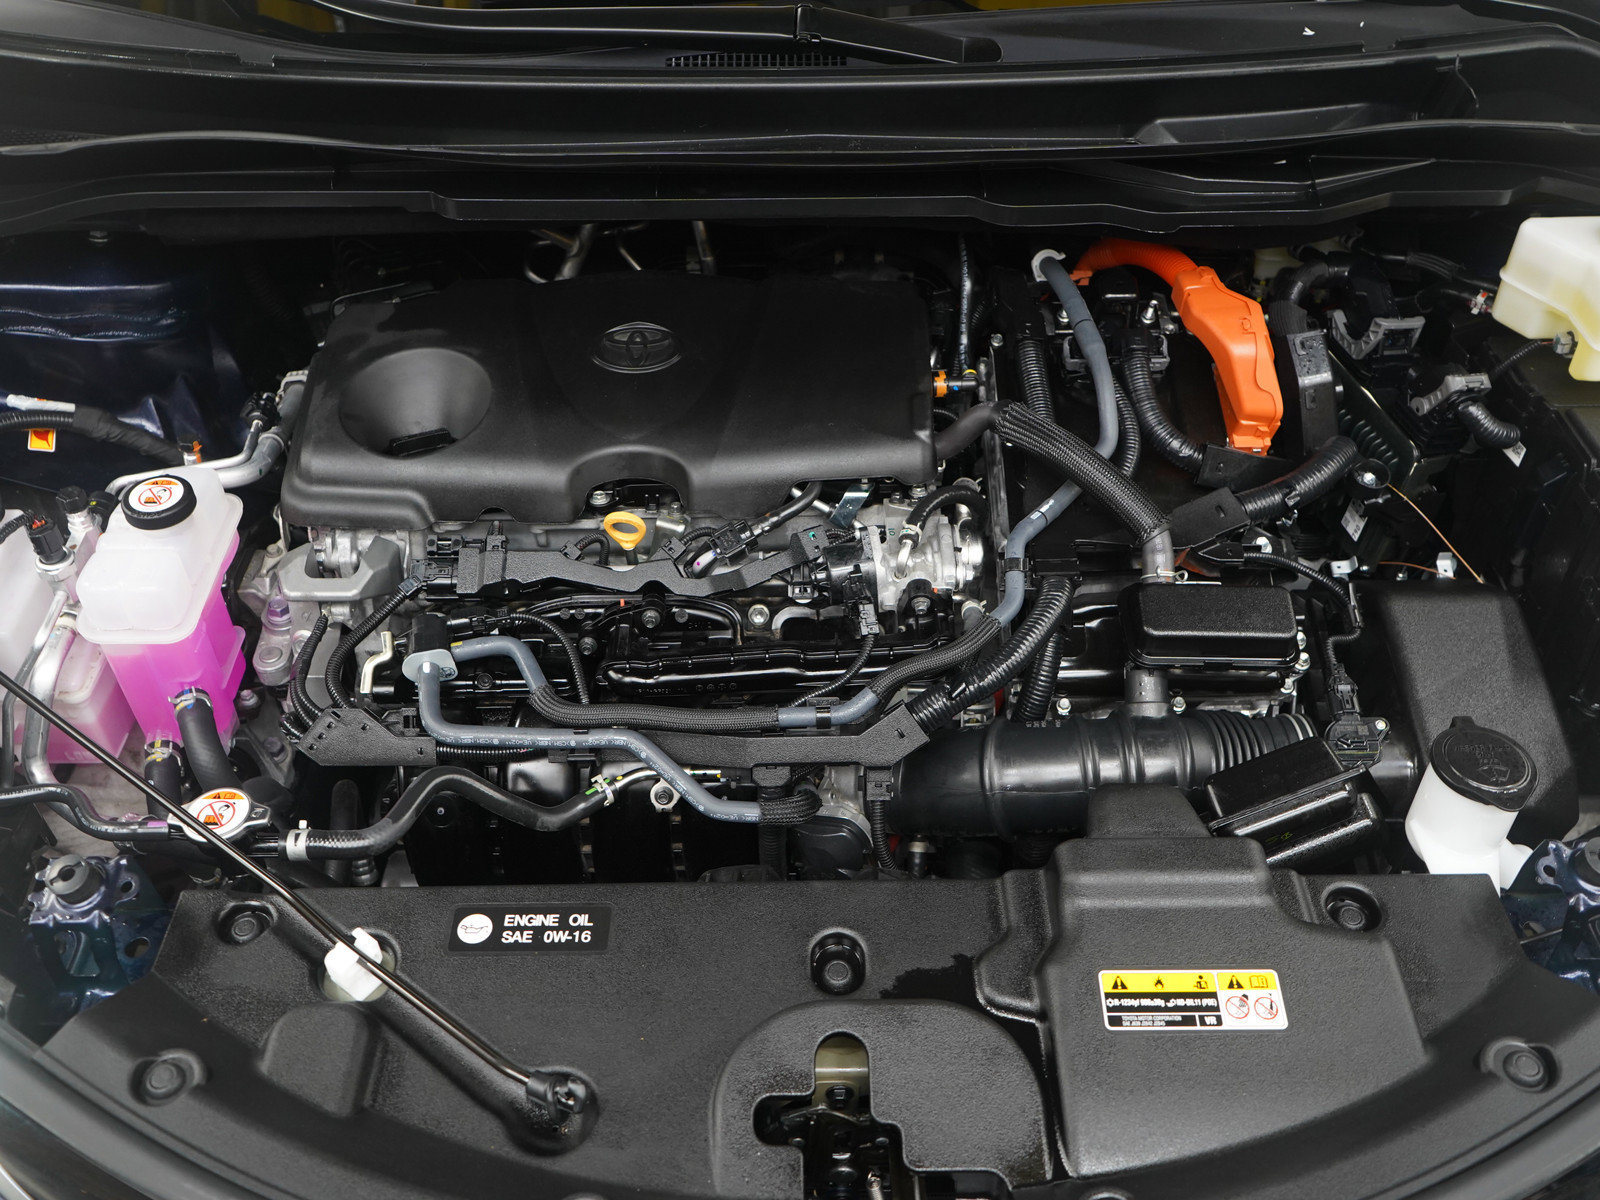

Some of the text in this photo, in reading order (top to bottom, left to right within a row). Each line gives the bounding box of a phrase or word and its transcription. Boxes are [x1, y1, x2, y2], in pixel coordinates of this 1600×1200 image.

[503, 913, 593, 927] ENGINE OIL
[501, 930, 592, 943] SAE 0W-16
[1203, 1015, 1217, 1025] VR
